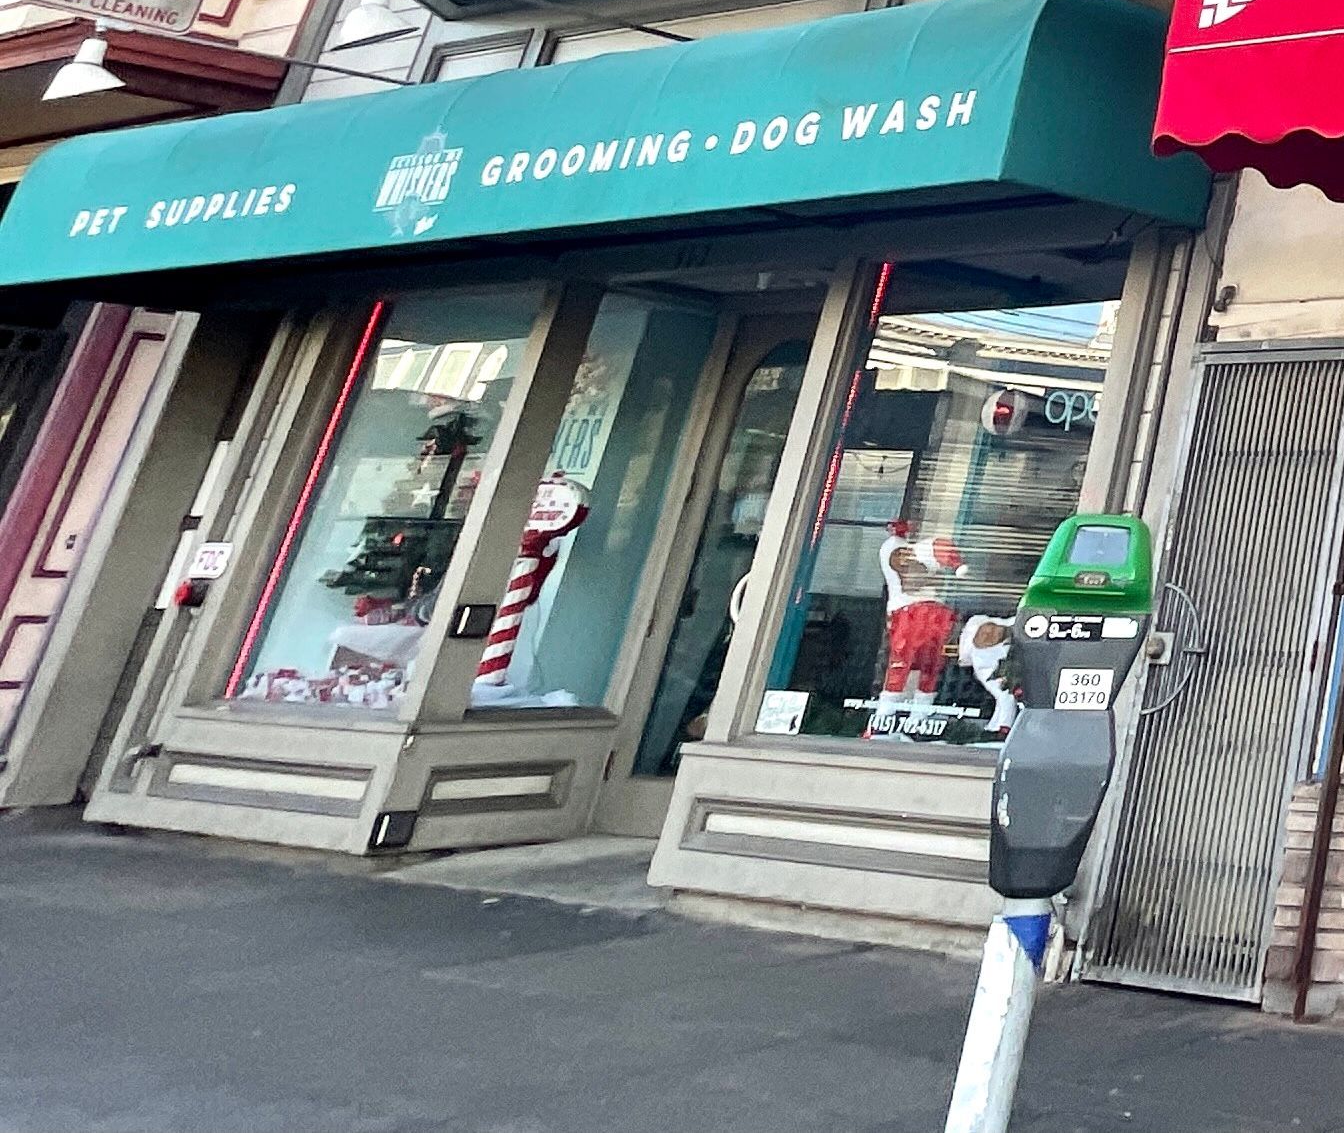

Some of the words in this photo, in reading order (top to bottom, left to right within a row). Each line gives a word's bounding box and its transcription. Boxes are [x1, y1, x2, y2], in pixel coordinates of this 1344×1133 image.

[480, 130, 693, 187] GROOMING
[728, 110, 822, 156] DOG
[840, 89, 978, 141] WASH
[68, 206, 130, 237] PET
[144, 183, 297, 230] SUPPLIES
[1070, 673, 1101, 686] 360
[1058, 691, 1106, 704] 03170
